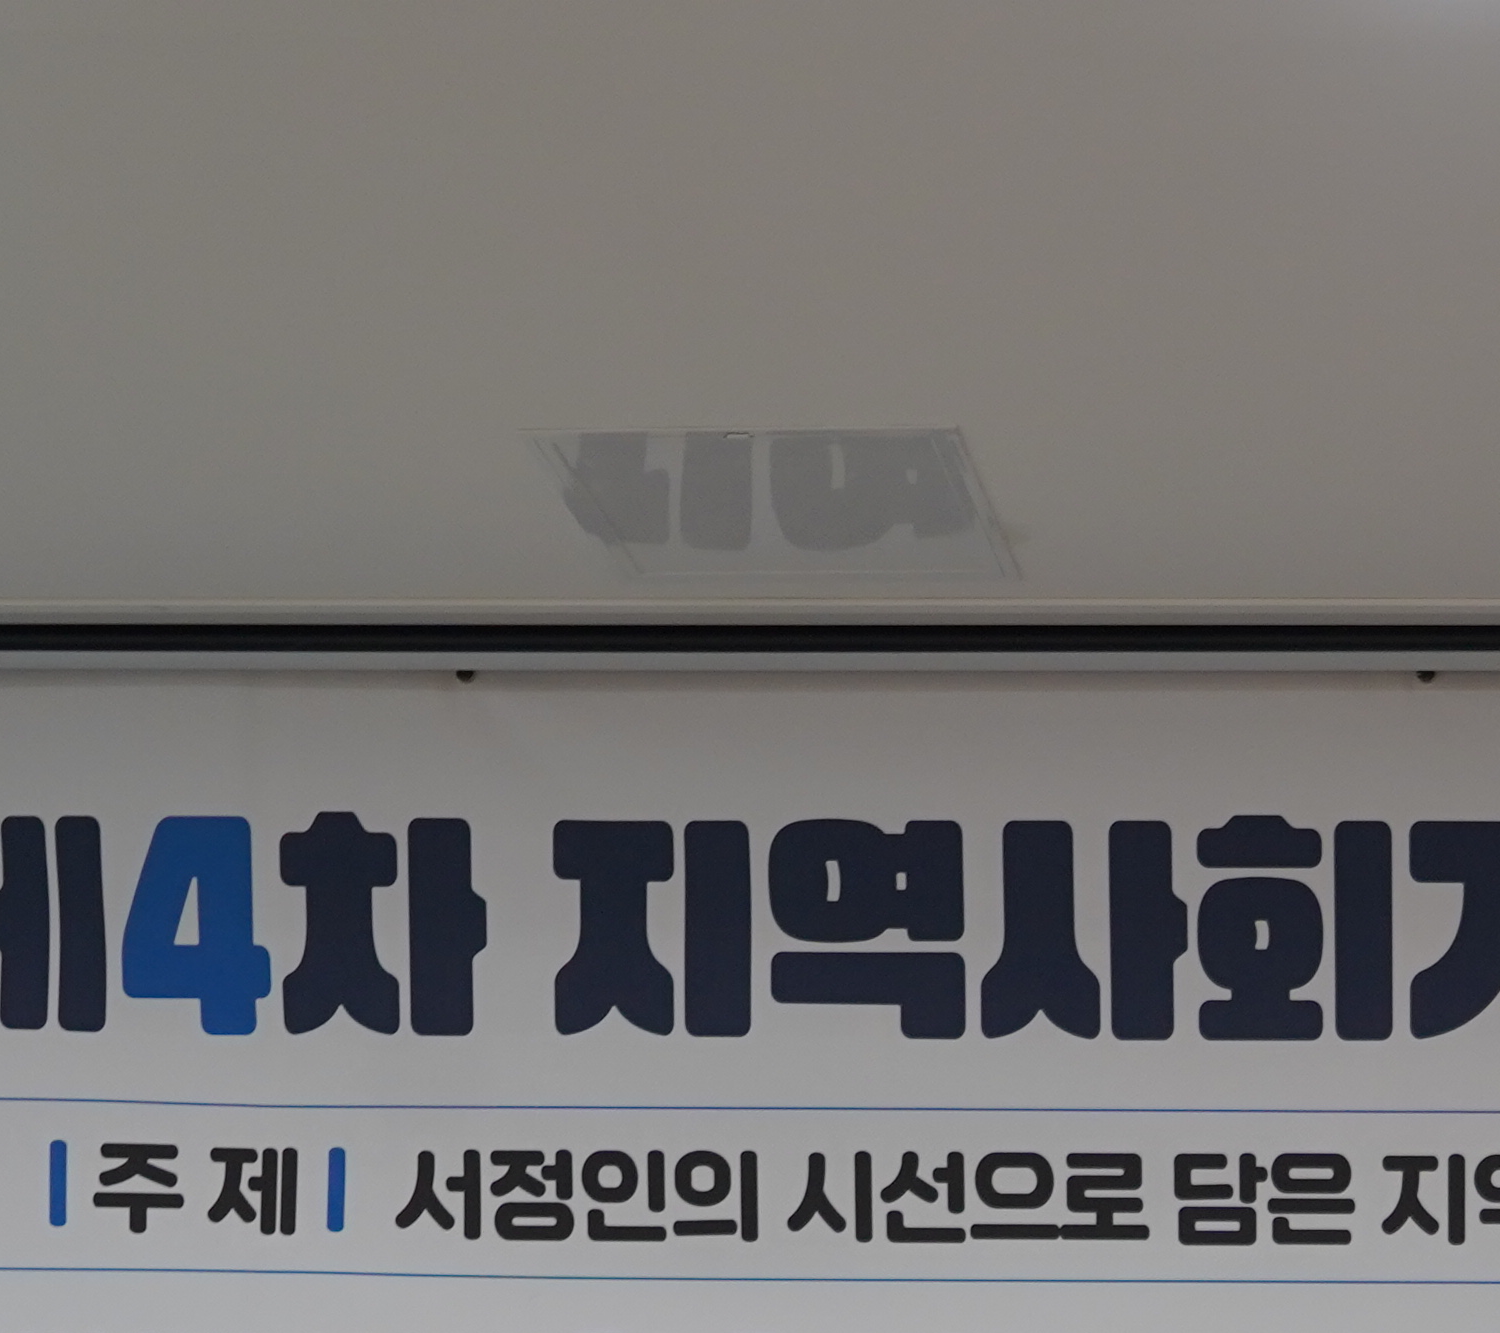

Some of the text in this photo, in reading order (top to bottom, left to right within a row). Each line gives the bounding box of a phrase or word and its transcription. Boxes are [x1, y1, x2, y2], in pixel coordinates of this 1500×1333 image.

[394, 1148, 759, 1243] 서정인의
[786, 1150, 1151, 1244] 시선으로
[1173, 1152, 1356, 1246] 담은
